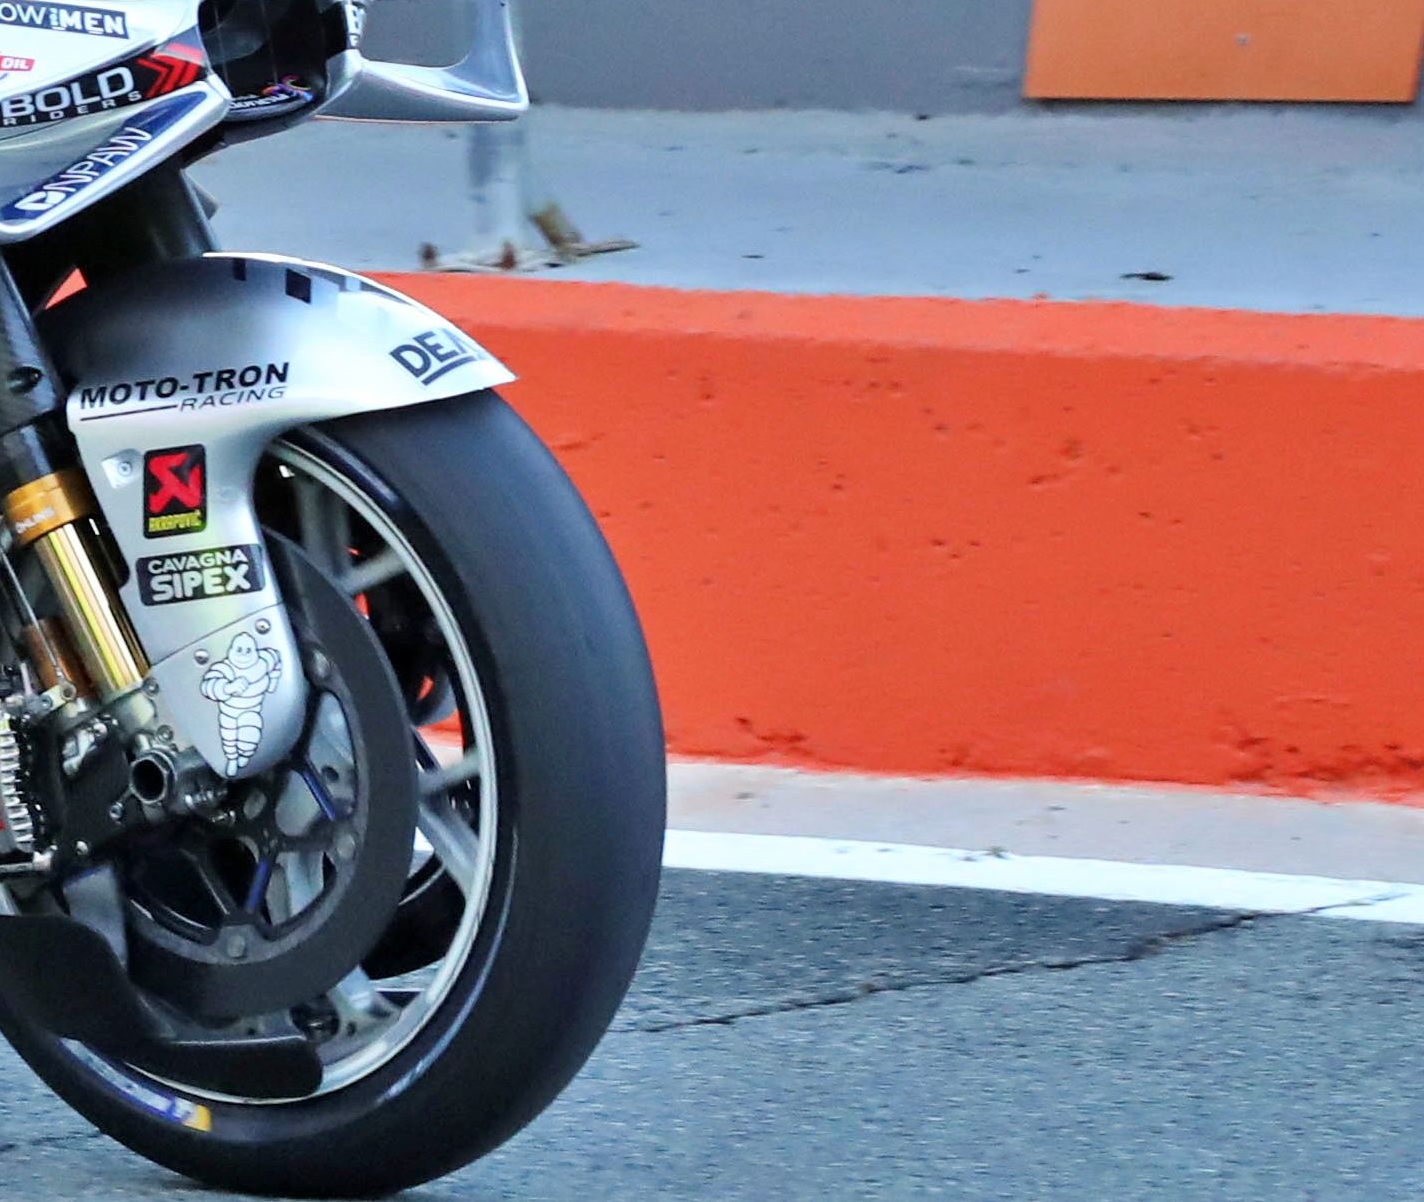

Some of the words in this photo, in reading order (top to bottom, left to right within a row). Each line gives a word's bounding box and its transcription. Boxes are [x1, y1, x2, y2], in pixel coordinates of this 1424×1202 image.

[58, 8, 125, 36] MEN
[0, 58, 30, 71] OIL
[1, 66, 135, 120] BOLD
[2, 91, 144, 127] RIDERS
[78, 360, 291, 411] MOTO-TRON
[178, 385, 290, 413] RACING
[147, 548, 250, 575] CAVAGNA
[151, 564, 252, 602] SIPEX
